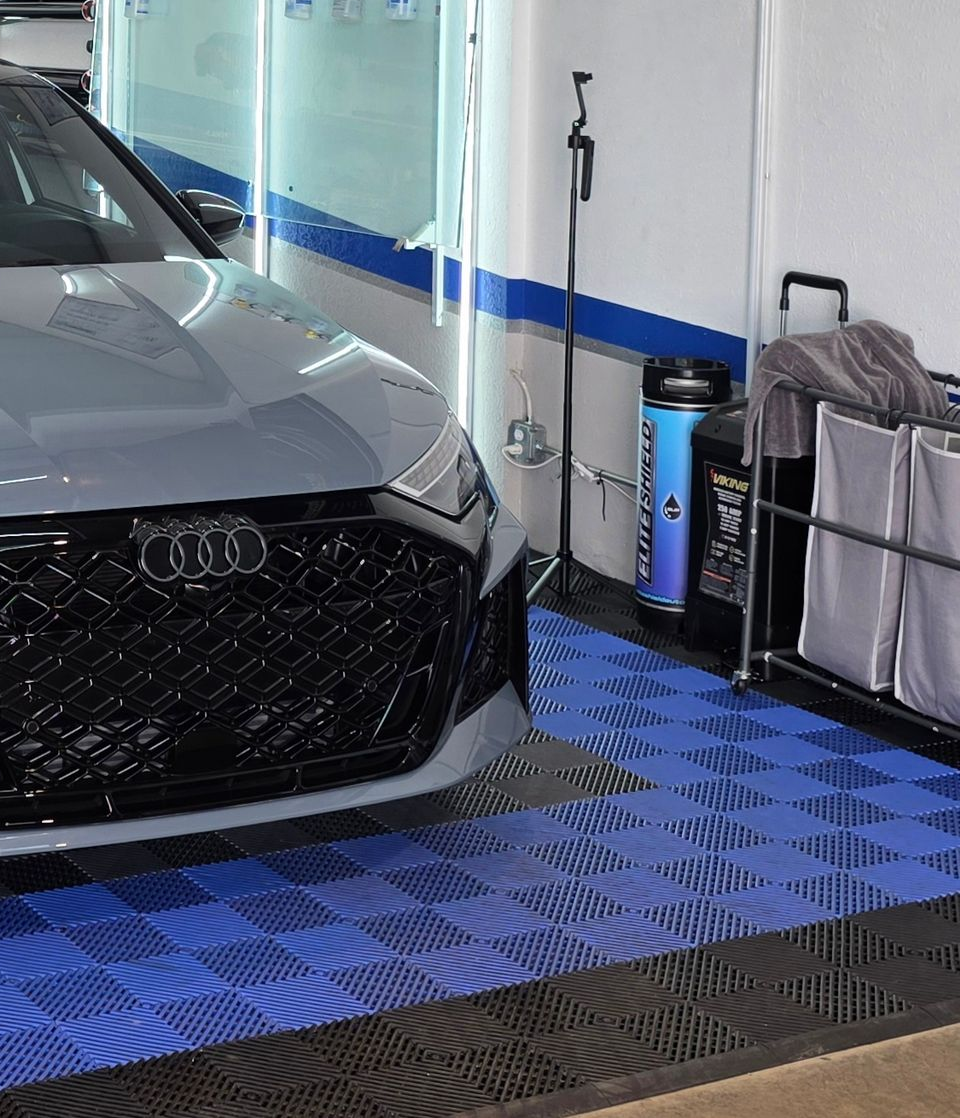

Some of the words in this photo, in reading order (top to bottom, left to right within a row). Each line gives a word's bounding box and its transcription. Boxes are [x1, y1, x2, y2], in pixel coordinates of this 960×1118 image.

[639, 420, 653, 507] SHIELD
[713, 473, 750, 493] VIKING
[637, 509, 651, 581] ELITE
